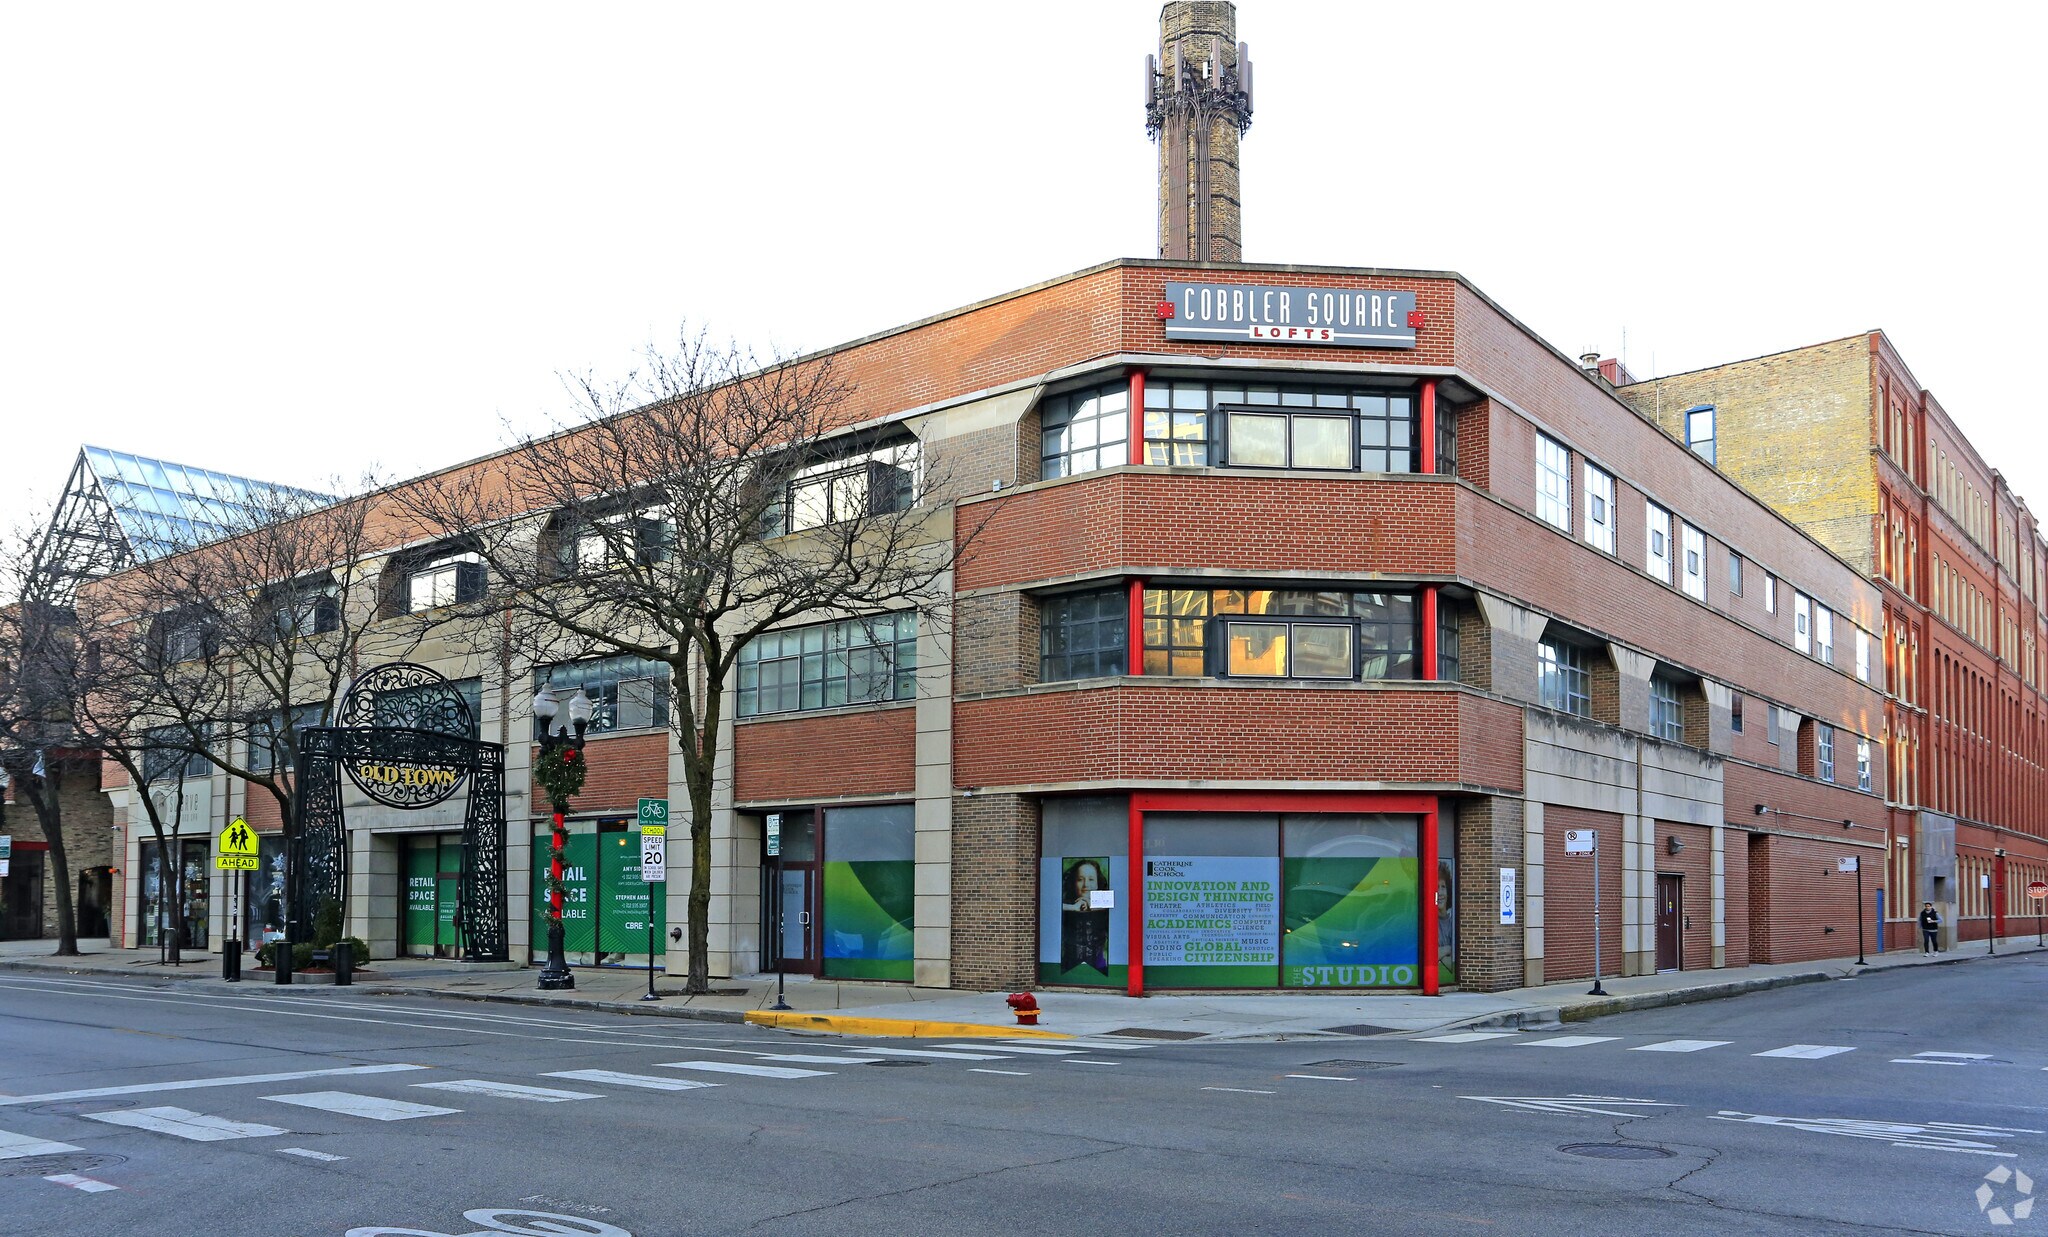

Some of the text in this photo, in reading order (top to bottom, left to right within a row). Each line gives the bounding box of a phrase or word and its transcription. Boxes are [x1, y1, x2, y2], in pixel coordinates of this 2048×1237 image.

[1184, 287, 1398, 328] COBBLER SQUARE
[1254, 326, 1330, 340] LOFTS
[360, 764, 456, 786] OLD TOWN
[643, 827, 663, 835] SCHOOL
[221, 858, 255, 868] AHEAD
[644, 852, 662, 864] 20
[543, 867, 587, 881] RTAIL
[409, 877, 435, 887] RETAIL
[1147, 881, 1270, 891] INNOVATION AND
[409, 891, 435, 900] SPACE
[543, 888, 587, 902] SCE
[2028, 886, 2047, 894] STOP
[1147, 892, 1274, 902] DESIGN THINKING
[625, 921, 644, 930] CBRE
[1147, 919, 1232, 929] ACADEMICS
[1184, 941, 1242, 952] GLOBAL
[1184, 952, 1275, 963] CITIZENSHIP
[1293, 967, 1301, 985] THE
[1302, 966, 1413, 986] STUDIO
